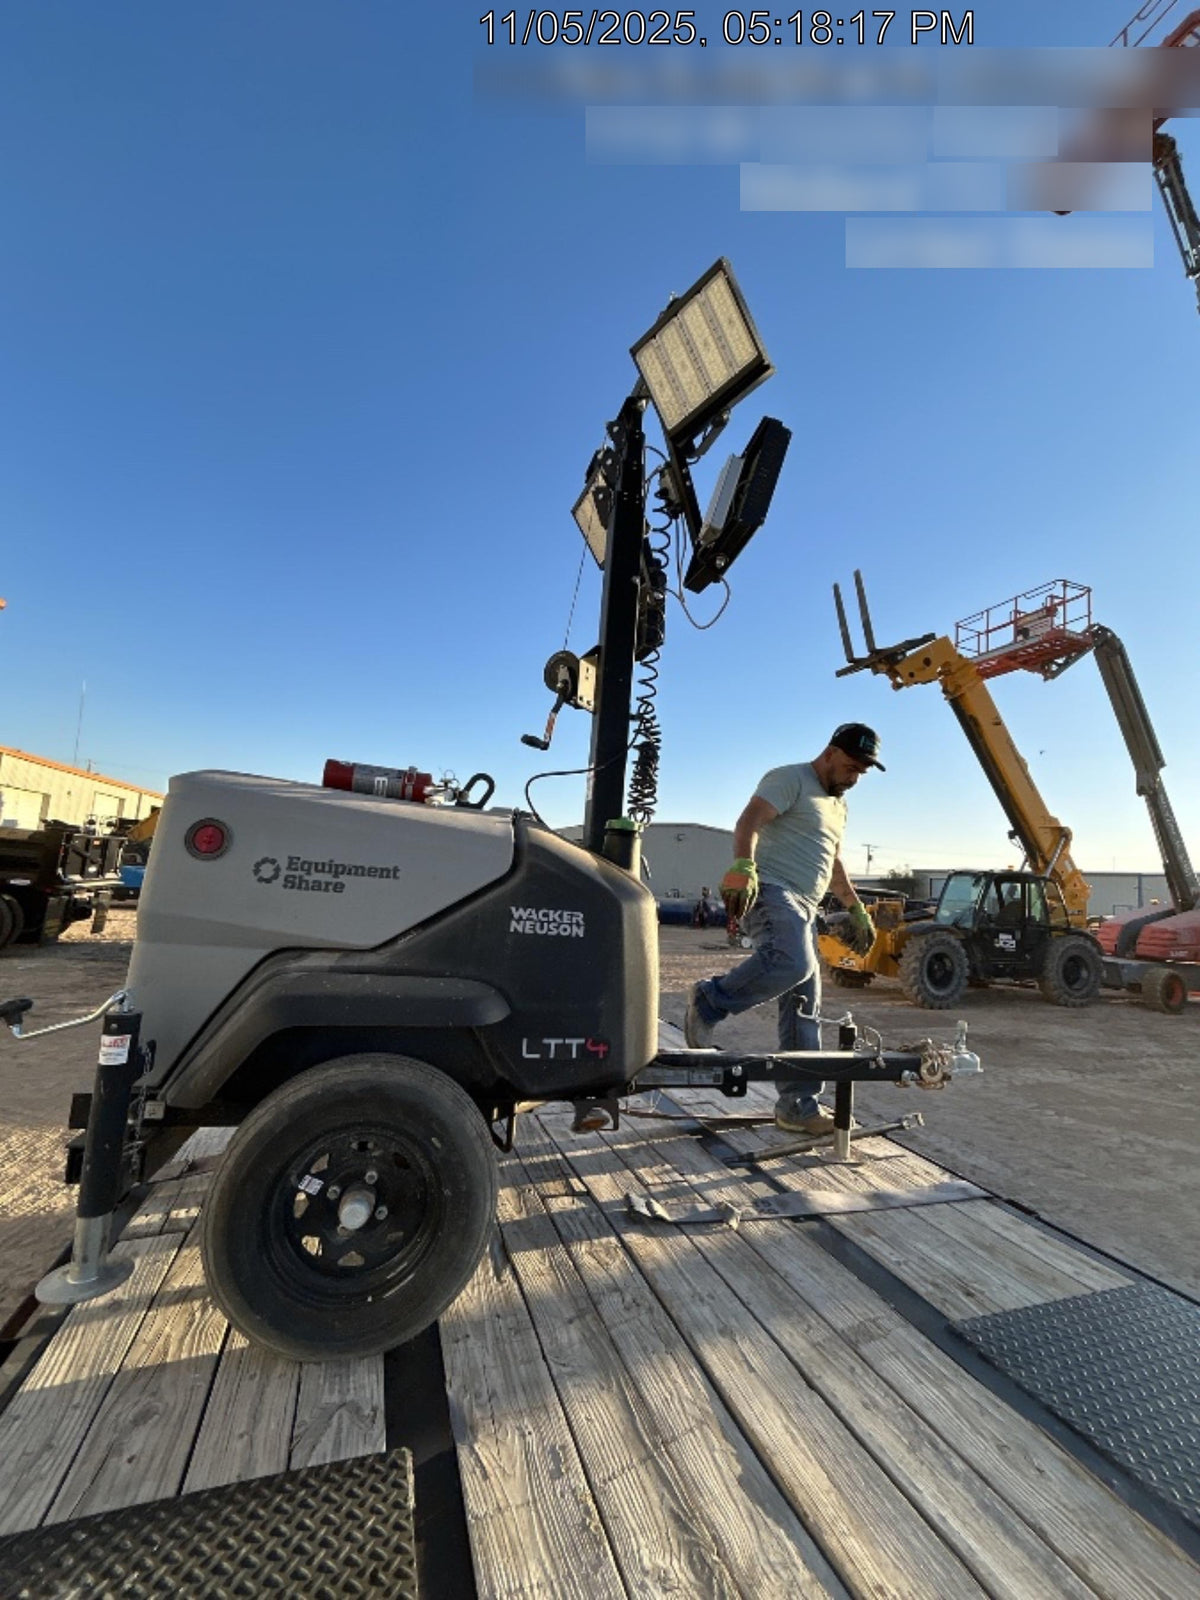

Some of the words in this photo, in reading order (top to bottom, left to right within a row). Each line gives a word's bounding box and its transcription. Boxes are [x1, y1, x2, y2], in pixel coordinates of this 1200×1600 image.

[286, 855, 401, 879] Equipment
[282, 874, 346, 893] Share
[510, 906, 585, 925] WACKER
[510, 920, 585, 938] NEUSON
[522, 1038, 609, 1059] LTT4
